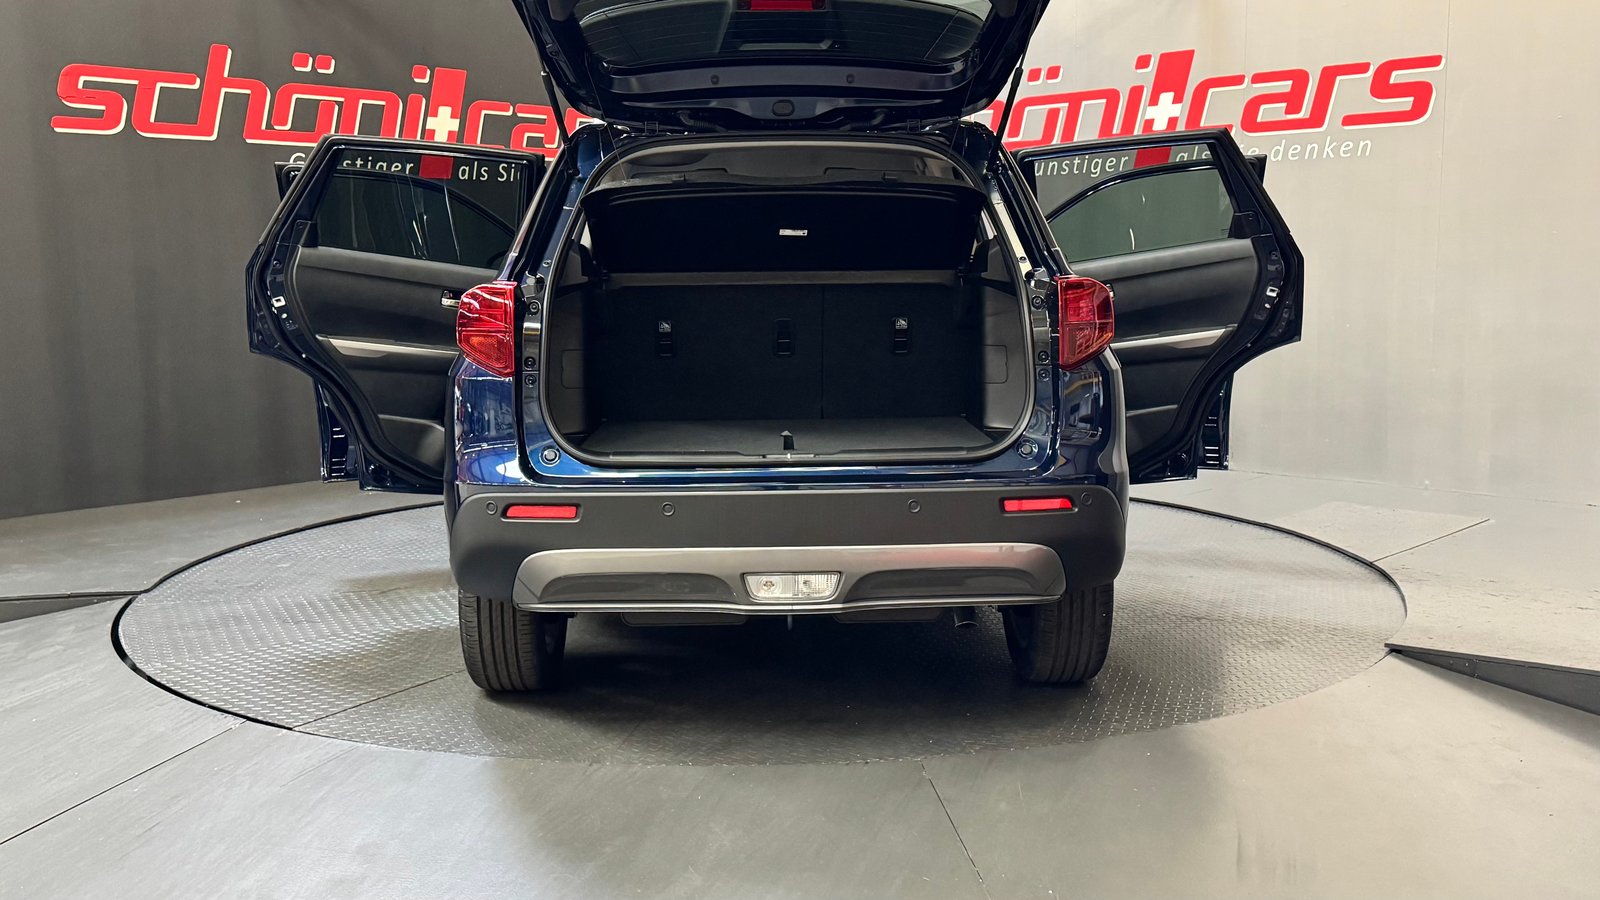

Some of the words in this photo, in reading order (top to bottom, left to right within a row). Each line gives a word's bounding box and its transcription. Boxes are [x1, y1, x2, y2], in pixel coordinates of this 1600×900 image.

[1270, 135, 1372, 162] denken
[458, 160, 489, 181] als
[497, 162, 521, 182] Si
